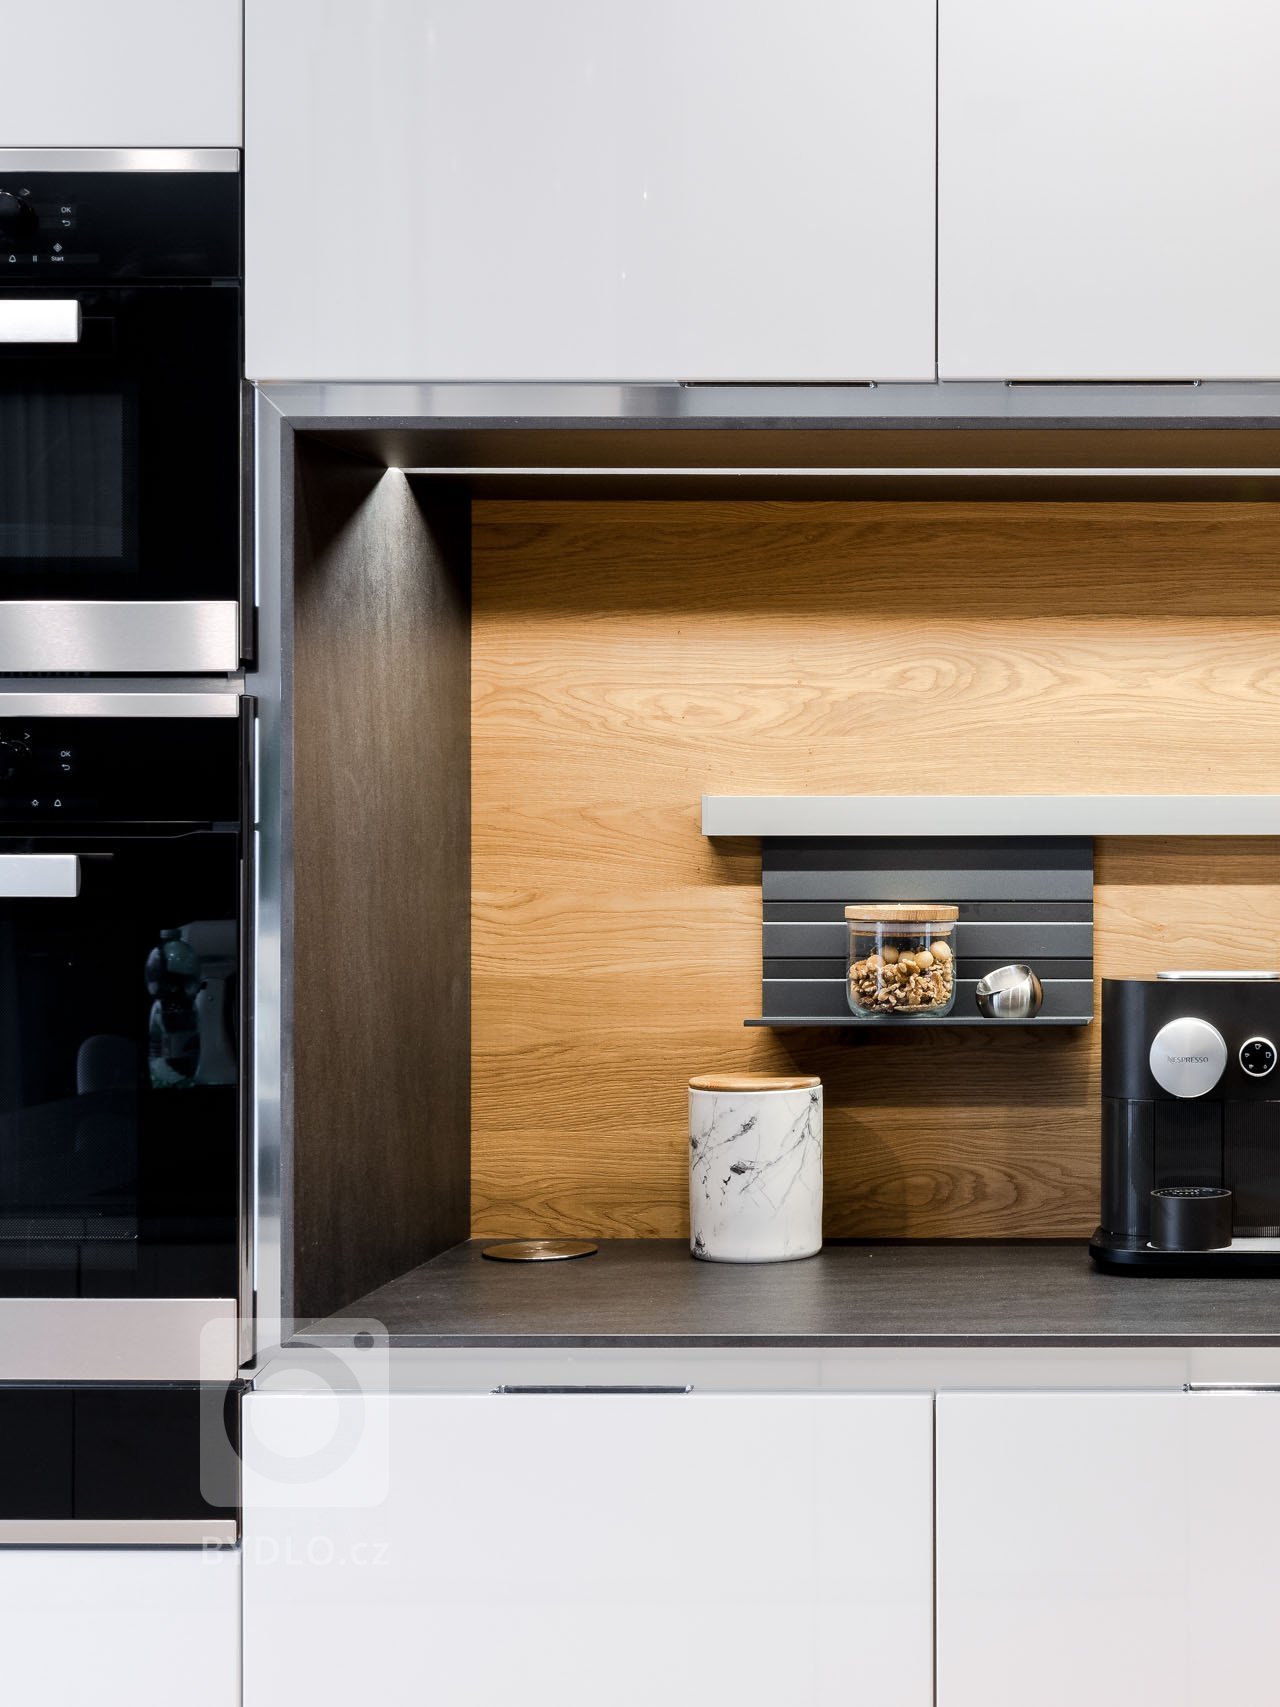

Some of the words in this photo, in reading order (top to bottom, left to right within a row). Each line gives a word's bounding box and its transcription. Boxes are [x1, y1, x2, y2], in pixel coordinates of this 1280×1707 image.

[60, 206, 72, 214] OK
[60, 750, 71, 758] OK
[1167, 1055, 1209, 1064] NESPRESSO
